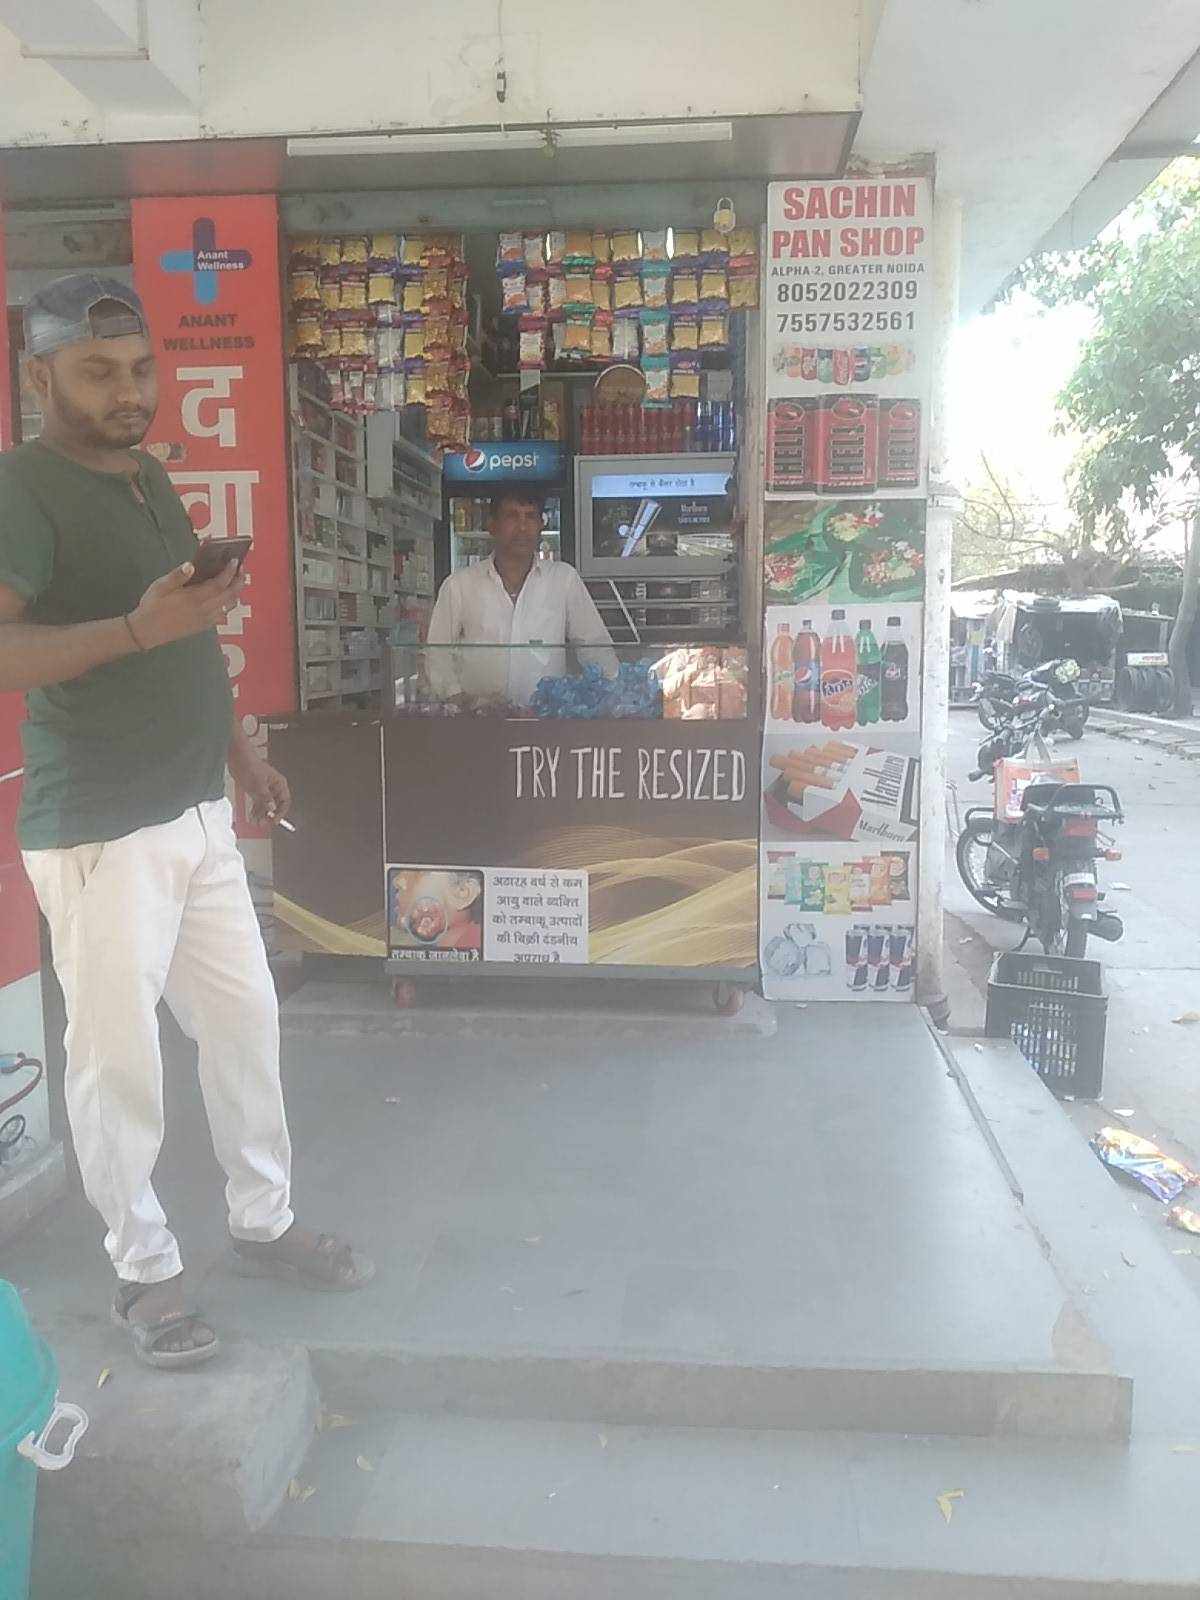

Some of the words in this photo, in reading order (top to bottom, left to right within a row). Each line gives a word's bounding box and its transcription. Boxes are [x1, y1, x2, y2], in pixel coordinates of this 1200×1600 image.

[783, 185, 916, 220] SACHIN
[772, 228, 831, 259] PAN
[840, 226, 924, 257] SHOP
[197, 250, 228, 260] Anant
[197, 260, 244, 271] Wellness
[828, 264, 882, 276] GREATER
[886, 263, 925, 275] NOIDA
[777, 280, 918, 302] 8052022309
[178, 313, 237, 328] ANANT
[776, 311, 915, 333] 7557532561
[163, 335, 256, 351] WELLNESS
[489, 452, 537, 471] pepsi
[508, 746, 560, 799] TRY
[570, 747, 626, 799] THE
[638, 748, 747, 801] RESIZED
[496, 896, 520, 909] आयु
